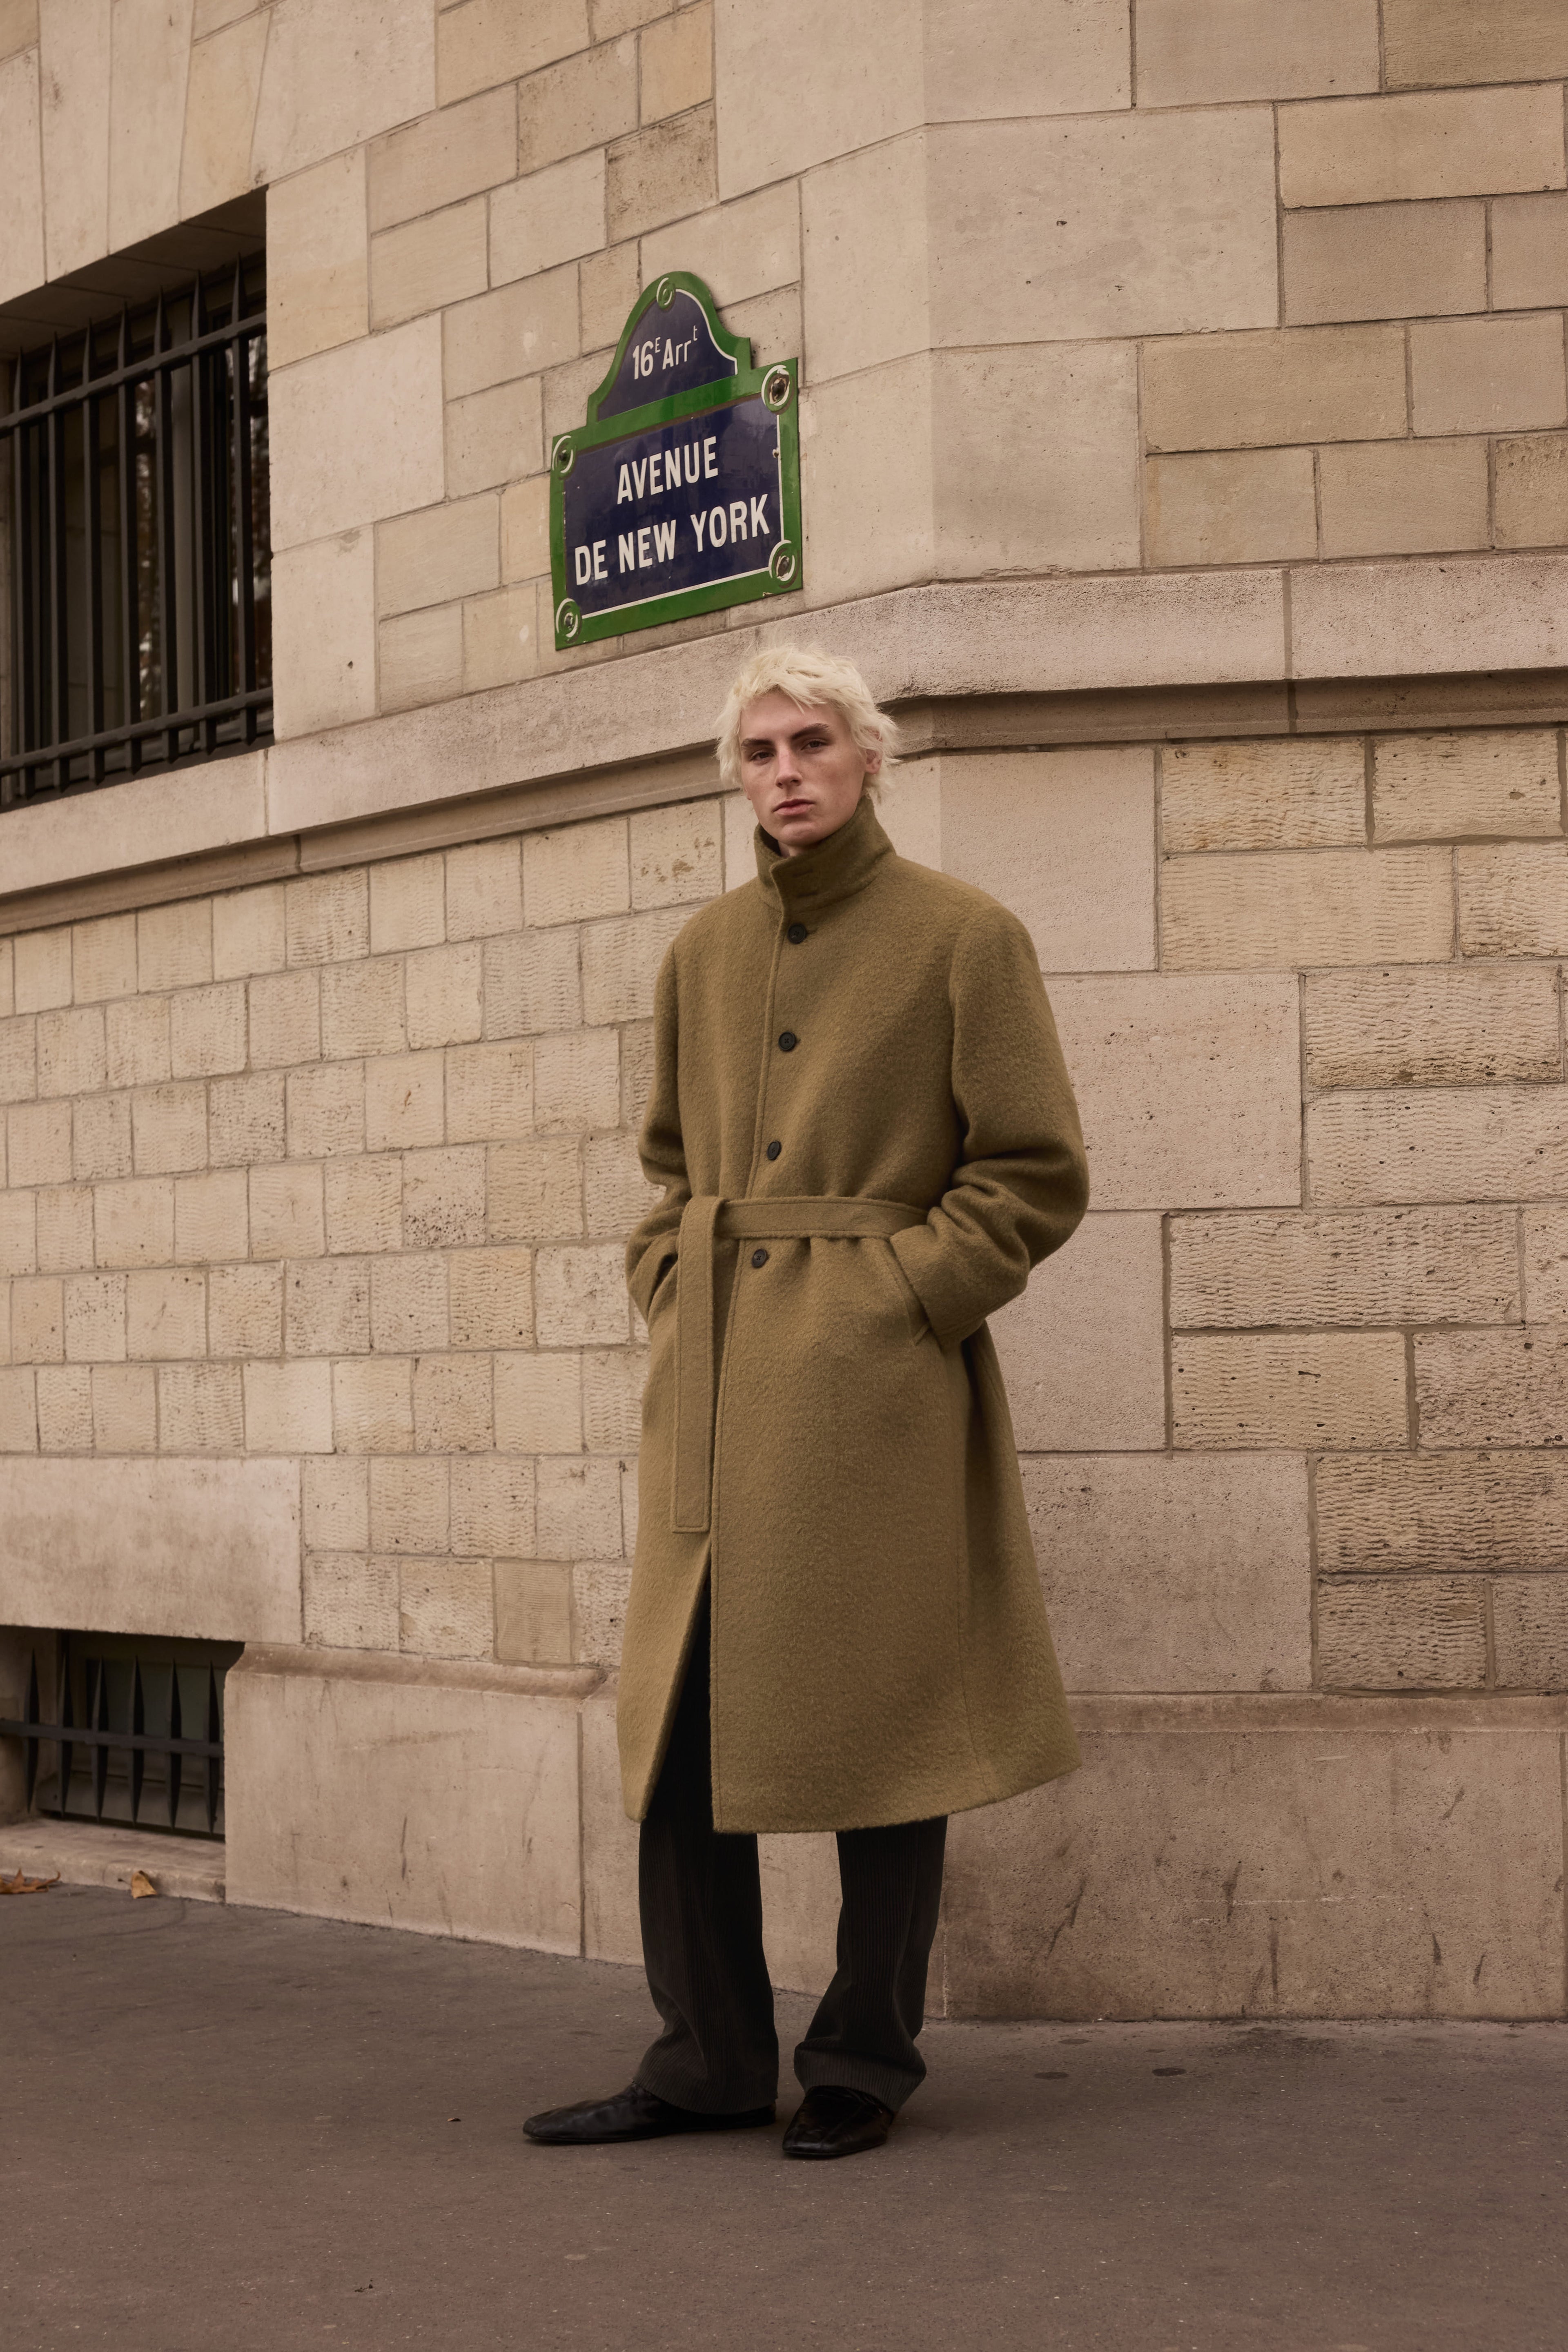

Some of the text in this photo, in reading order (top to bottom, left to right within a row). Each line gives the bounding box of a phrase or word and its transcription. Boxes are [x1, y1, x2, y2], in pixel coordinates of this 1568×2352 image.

[617, 436, 718, 505] AVENUE
[575, 494, 770, 586] DE NEW YORK
